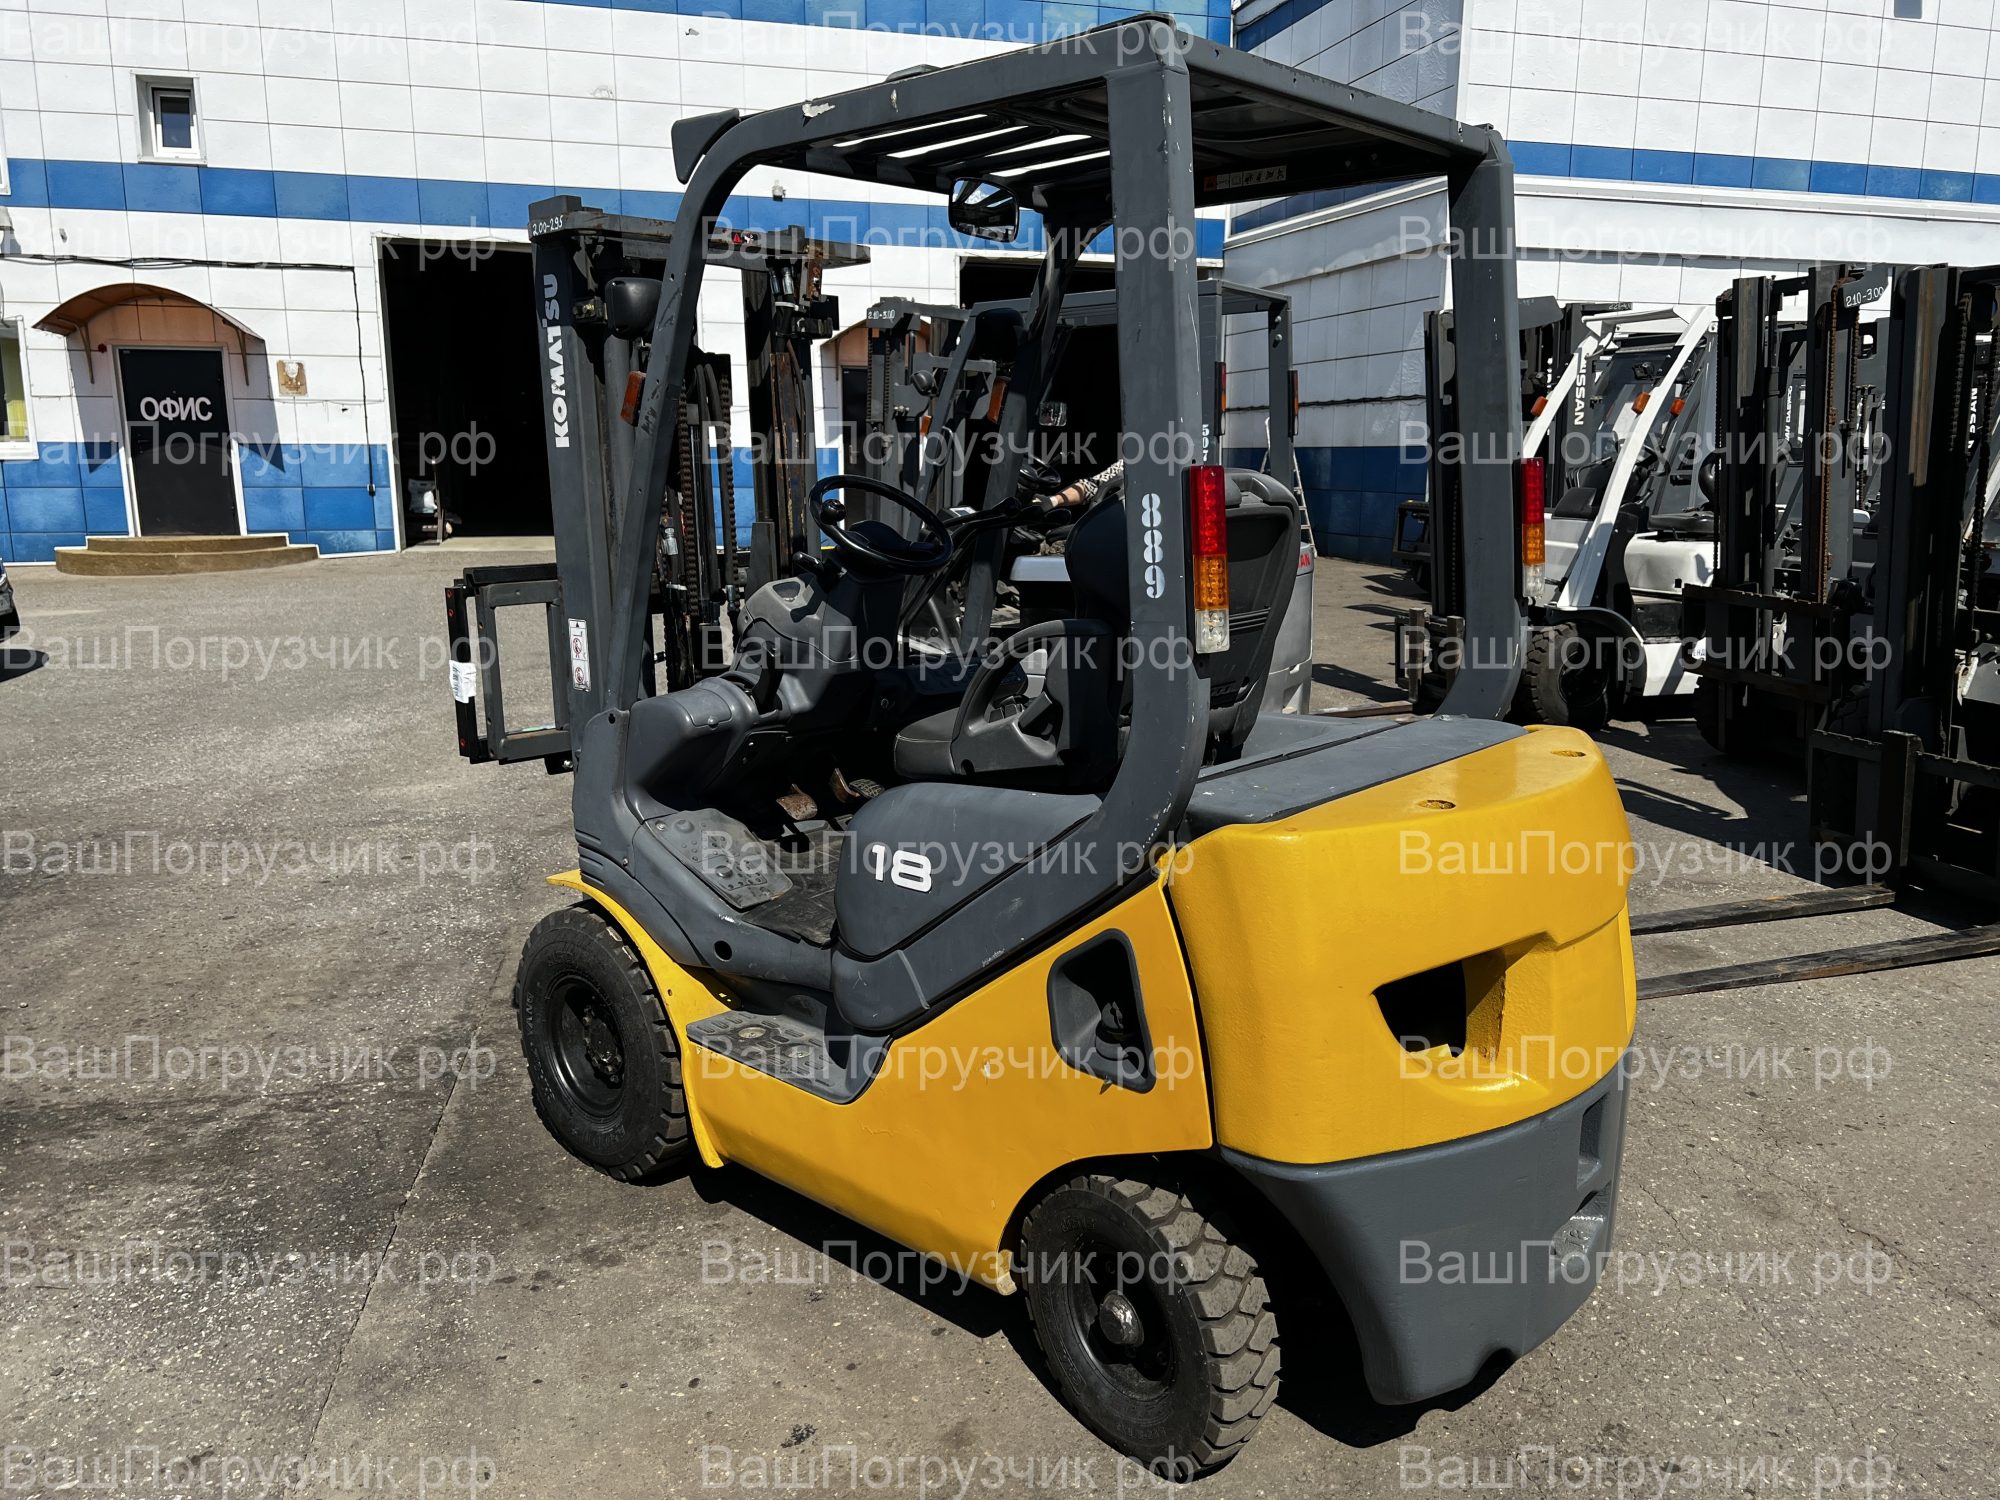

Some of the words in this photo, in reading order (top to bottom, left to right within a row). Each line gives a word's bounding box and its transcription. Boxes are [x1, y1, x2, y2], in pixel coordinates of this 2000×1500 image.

[542, 273, 570, 448] KOMATSU
[140, 396, 213, 421] ОФИС
[1202, 424, 1210, 462] 507
[1141, 493, 1166, 599] 889
[872, 844, 932, 893] 18
